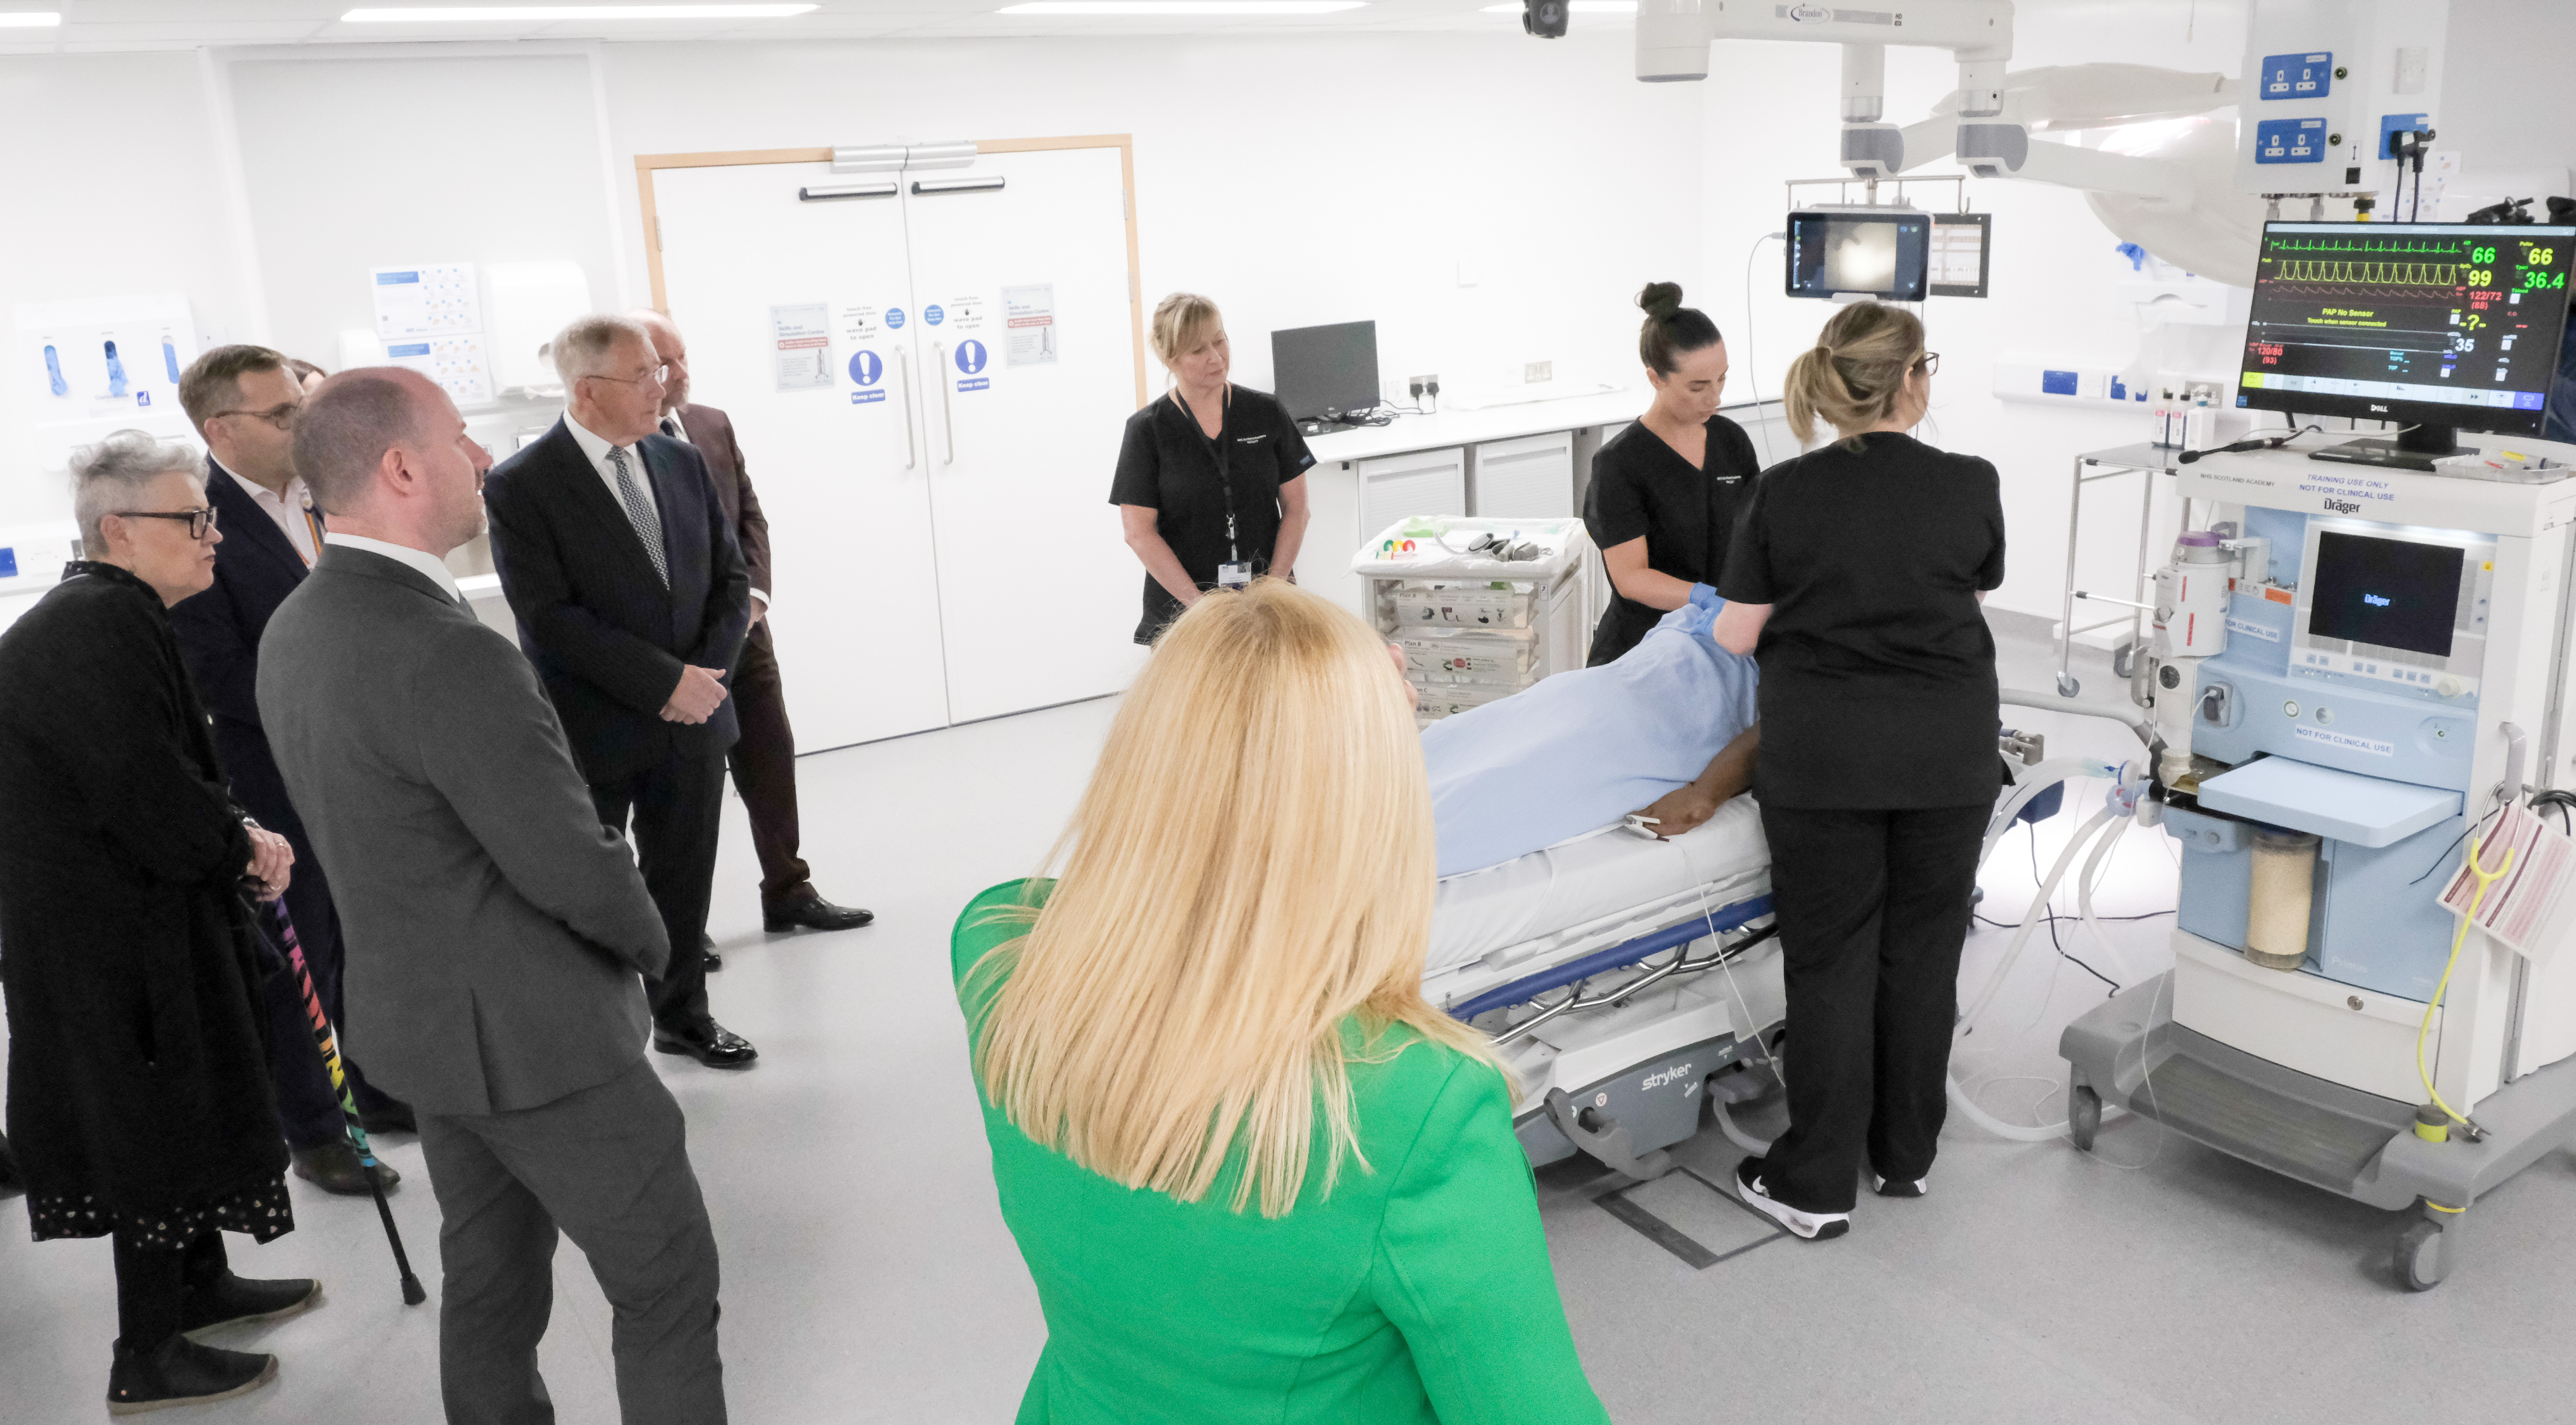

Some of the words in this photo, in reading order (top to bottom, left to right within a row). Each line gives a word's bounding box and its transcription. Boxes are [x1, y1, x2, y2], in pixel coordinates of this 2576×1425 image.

[2472, 247, 2496, 264] 66
[2529, 248, 2554, 265] 66
[2468, 270, 2492, 287] 99
[2524, 271, 2565, 289] 36.4
[2469, 291, 2503, 301] 122/72
[2258, 347, 2283, 356] 120/80
[2455, 338, 2475, 352] 35
[2262, 356, 2277, 365] (93)
[2370, 404, 2388, 412] DELL
[2214, 475, 2245, 483] SCOTLAND
[2307, 474, 2345, 484] TRAINING
[2337, 488, 2375, 499] CLINICAL
[2324, 498, 2361, 514] Dräger
[2364, 594, 2391, 606] Dräger
[2237, 623, 2264, 635] CLINICAL
[2266, 630, 2278, 639] USE
[2315, 732, 2332, 741] FOR
[2334, 736, 2371, 749] CLINICAL
[2374, 745, 2392, 753] USE
[1641, 1063, 1692, 1091] stryker
